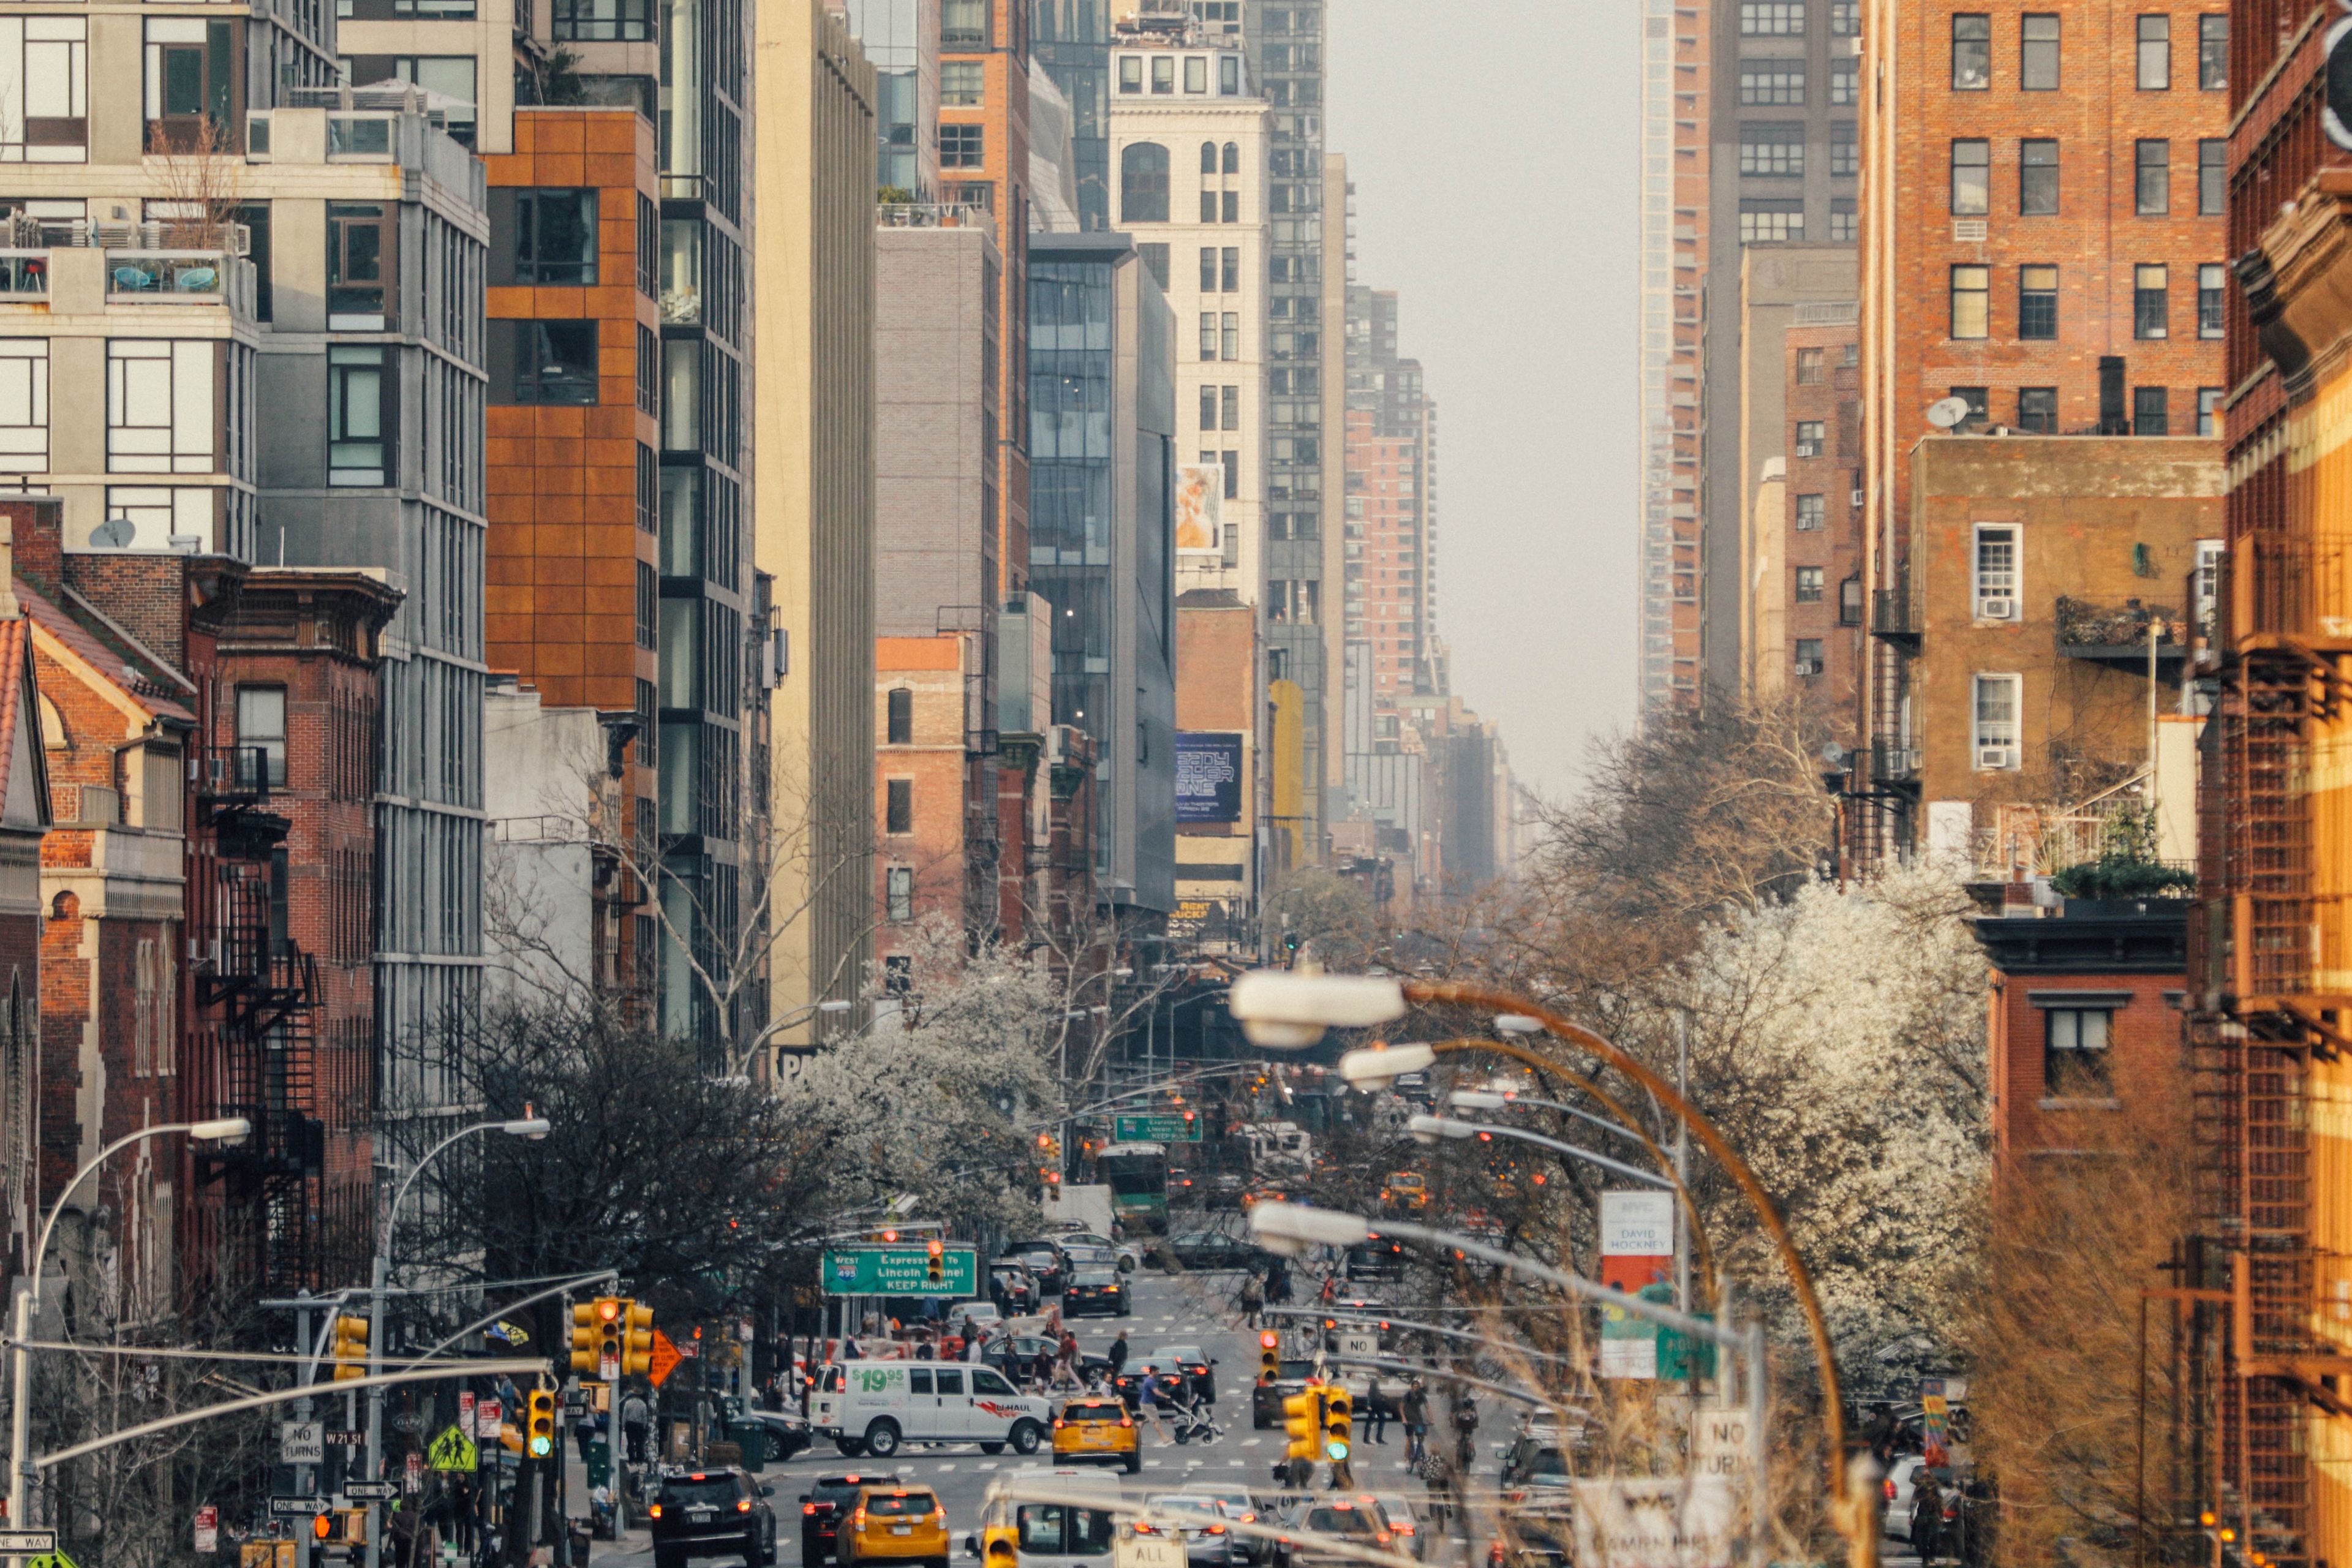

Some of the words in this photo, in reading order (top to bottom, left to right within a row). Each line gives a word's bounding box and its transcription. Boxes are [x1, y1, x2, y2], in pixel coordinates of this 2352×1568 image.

[1621, 1229, 1656, 1239] DAVID
[1611, 1240, 1667, 1250] HOCKNEY
[947, 1256, 959, 1264] To
[878, 1268, 921, 1278] Lincoln
[887, 1281, 918, 1290] KEEP
[921, 1280, 955, 1290] RIGHT
[1351, 1340, 1367, 1351] NO
[293, 1428, 311, 1441] NO
[326, 1433, 336, 1444] W
[338, 1434, 347, 1444] 21
[352, 1433, 361, 1444] St
[1713, 1423, 1744, 1444] NO
[285, 1446, 320, 1457] TURNS
[25, 1538, 50, 1548] WAY
[1136, 1547, 1165, 1562] ALL
